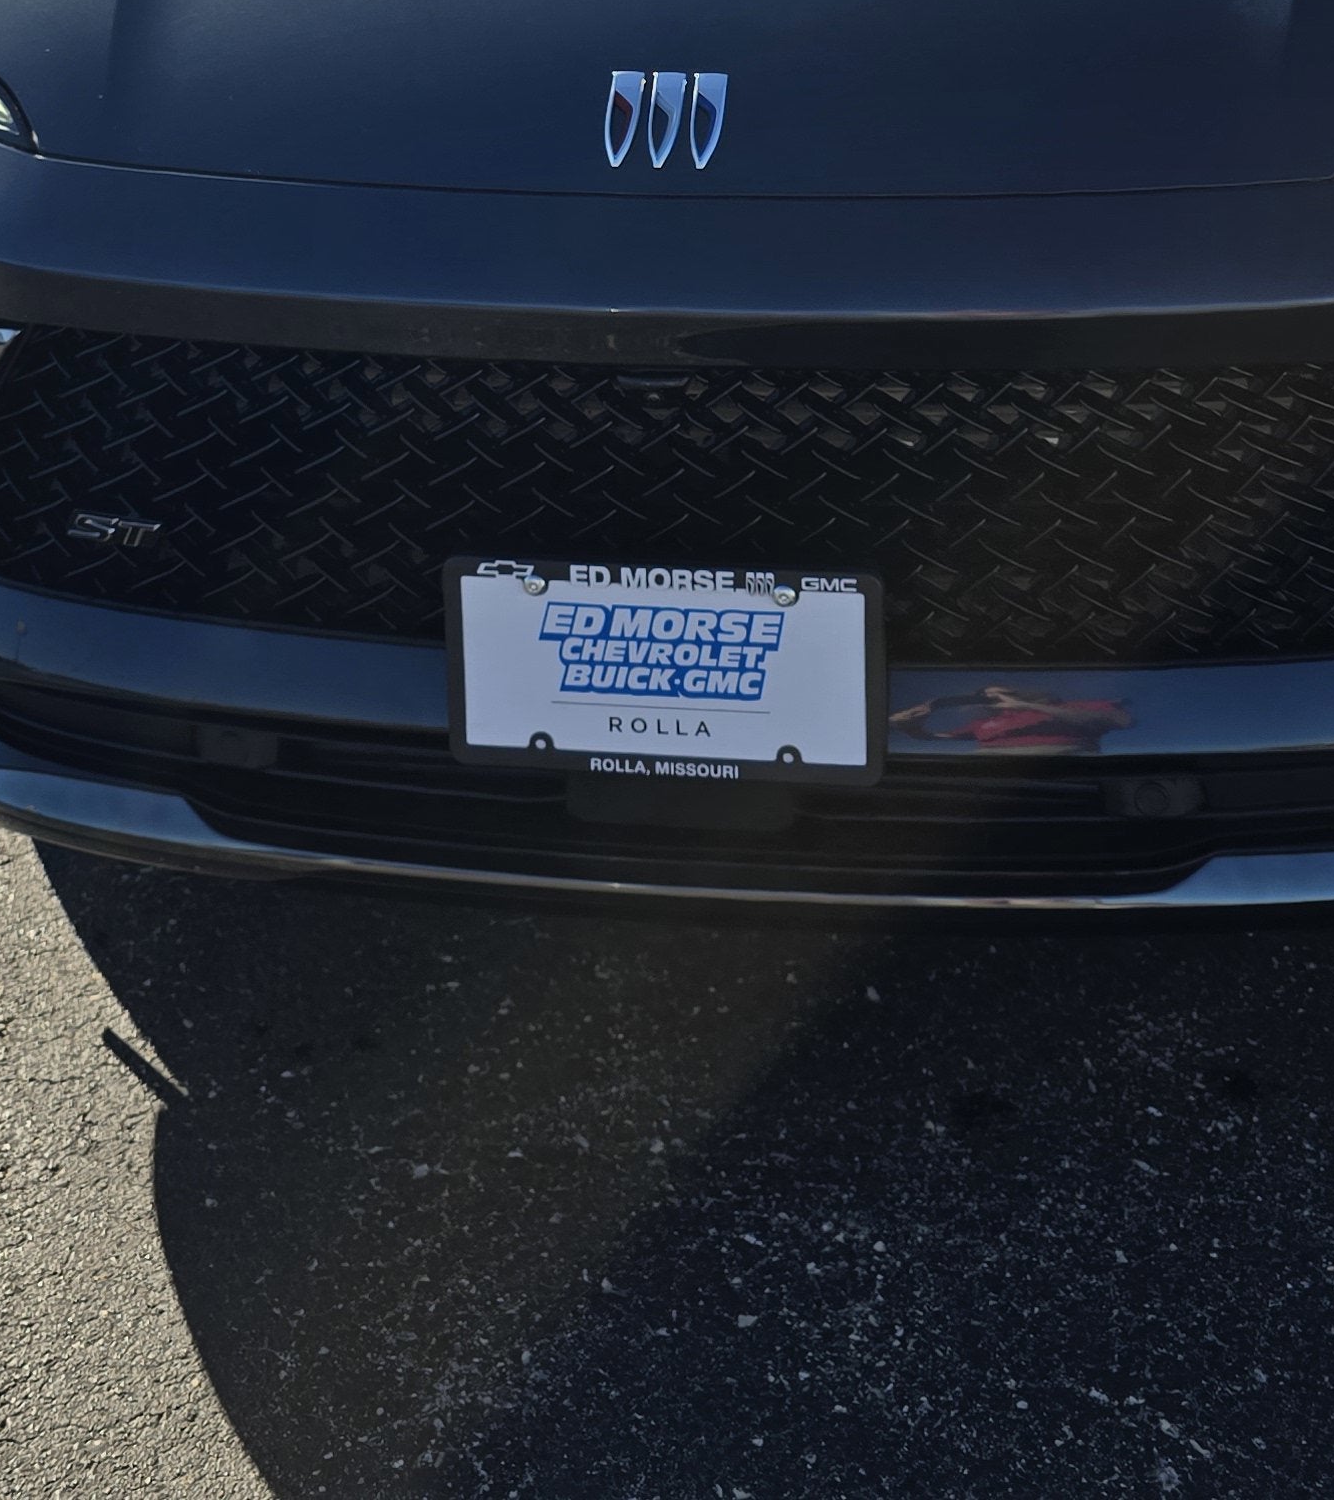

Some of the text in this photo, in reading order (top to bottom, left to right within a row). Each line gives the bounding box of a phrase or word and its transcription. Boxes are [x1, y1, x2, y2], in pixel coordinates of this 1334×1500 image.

[67, 513, 162, 547] ST
[569, 564, 735, 592] ED MORSE
[801, 576, 858, 592] GMC
[542, 604, 783, 644] ED MORSE
[561, 637, 764, 669] CHEVROLET
[609, 716, 711, 738] ROLLA
[590, 757, 739, 779] ROLLA, MISSOURI
